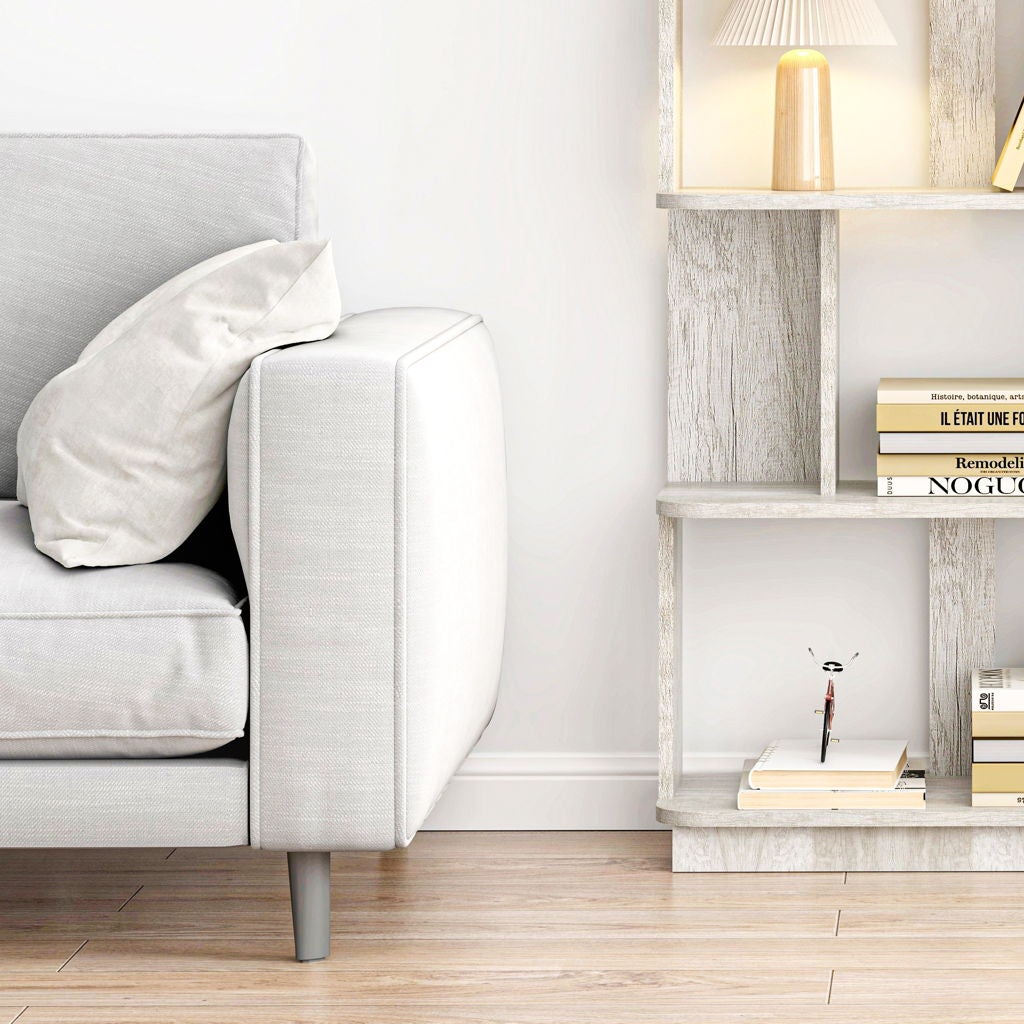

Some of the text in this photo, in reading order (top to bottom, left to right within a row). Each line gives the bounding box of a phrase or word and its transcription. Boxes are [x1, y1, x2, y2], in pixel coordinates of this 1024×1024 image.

[931, 393, 965, 401] Histoire,
[967, 393, 1007, 402] botanique,
[940, 411, 951, 426] IL
[953, 409, 984, 426] ÉTAIT
[987, 411, 1009, 426] UNE
